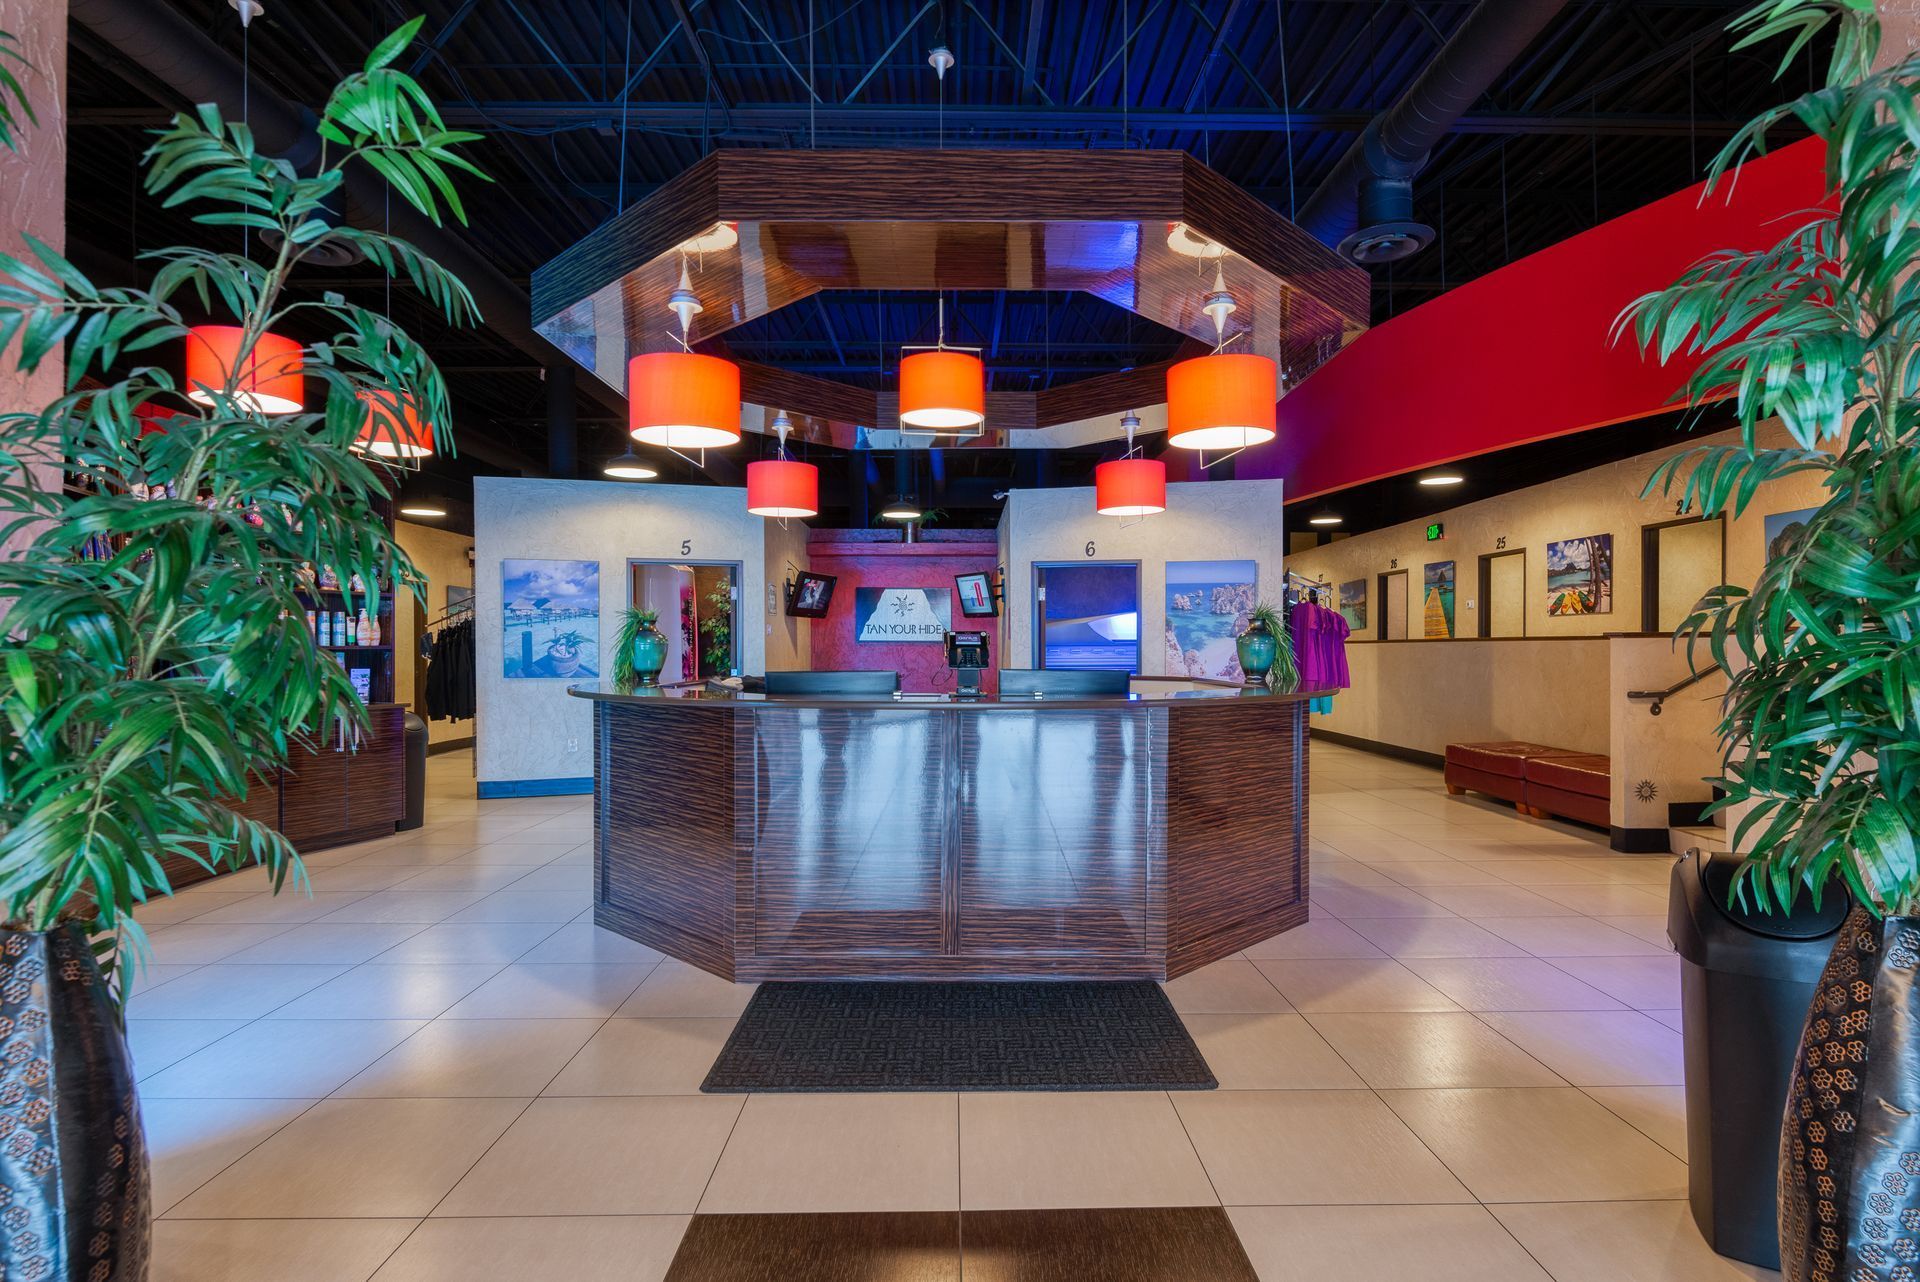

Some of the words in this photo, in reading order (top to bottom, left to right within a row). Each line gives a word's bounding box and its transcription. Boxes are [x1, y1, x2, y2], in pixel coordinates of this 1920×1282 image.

[681, 539, 692, 556] 5
[1085, 541, 1095, 557] 6
[1496, 536, 1506, 550] 25
[1390, 558, 1398, 569] 26
[866, 624, 887, 635] TAN
[889, 624, 917, 635] YOUR
[919, 624, 942, 635] HIDE
